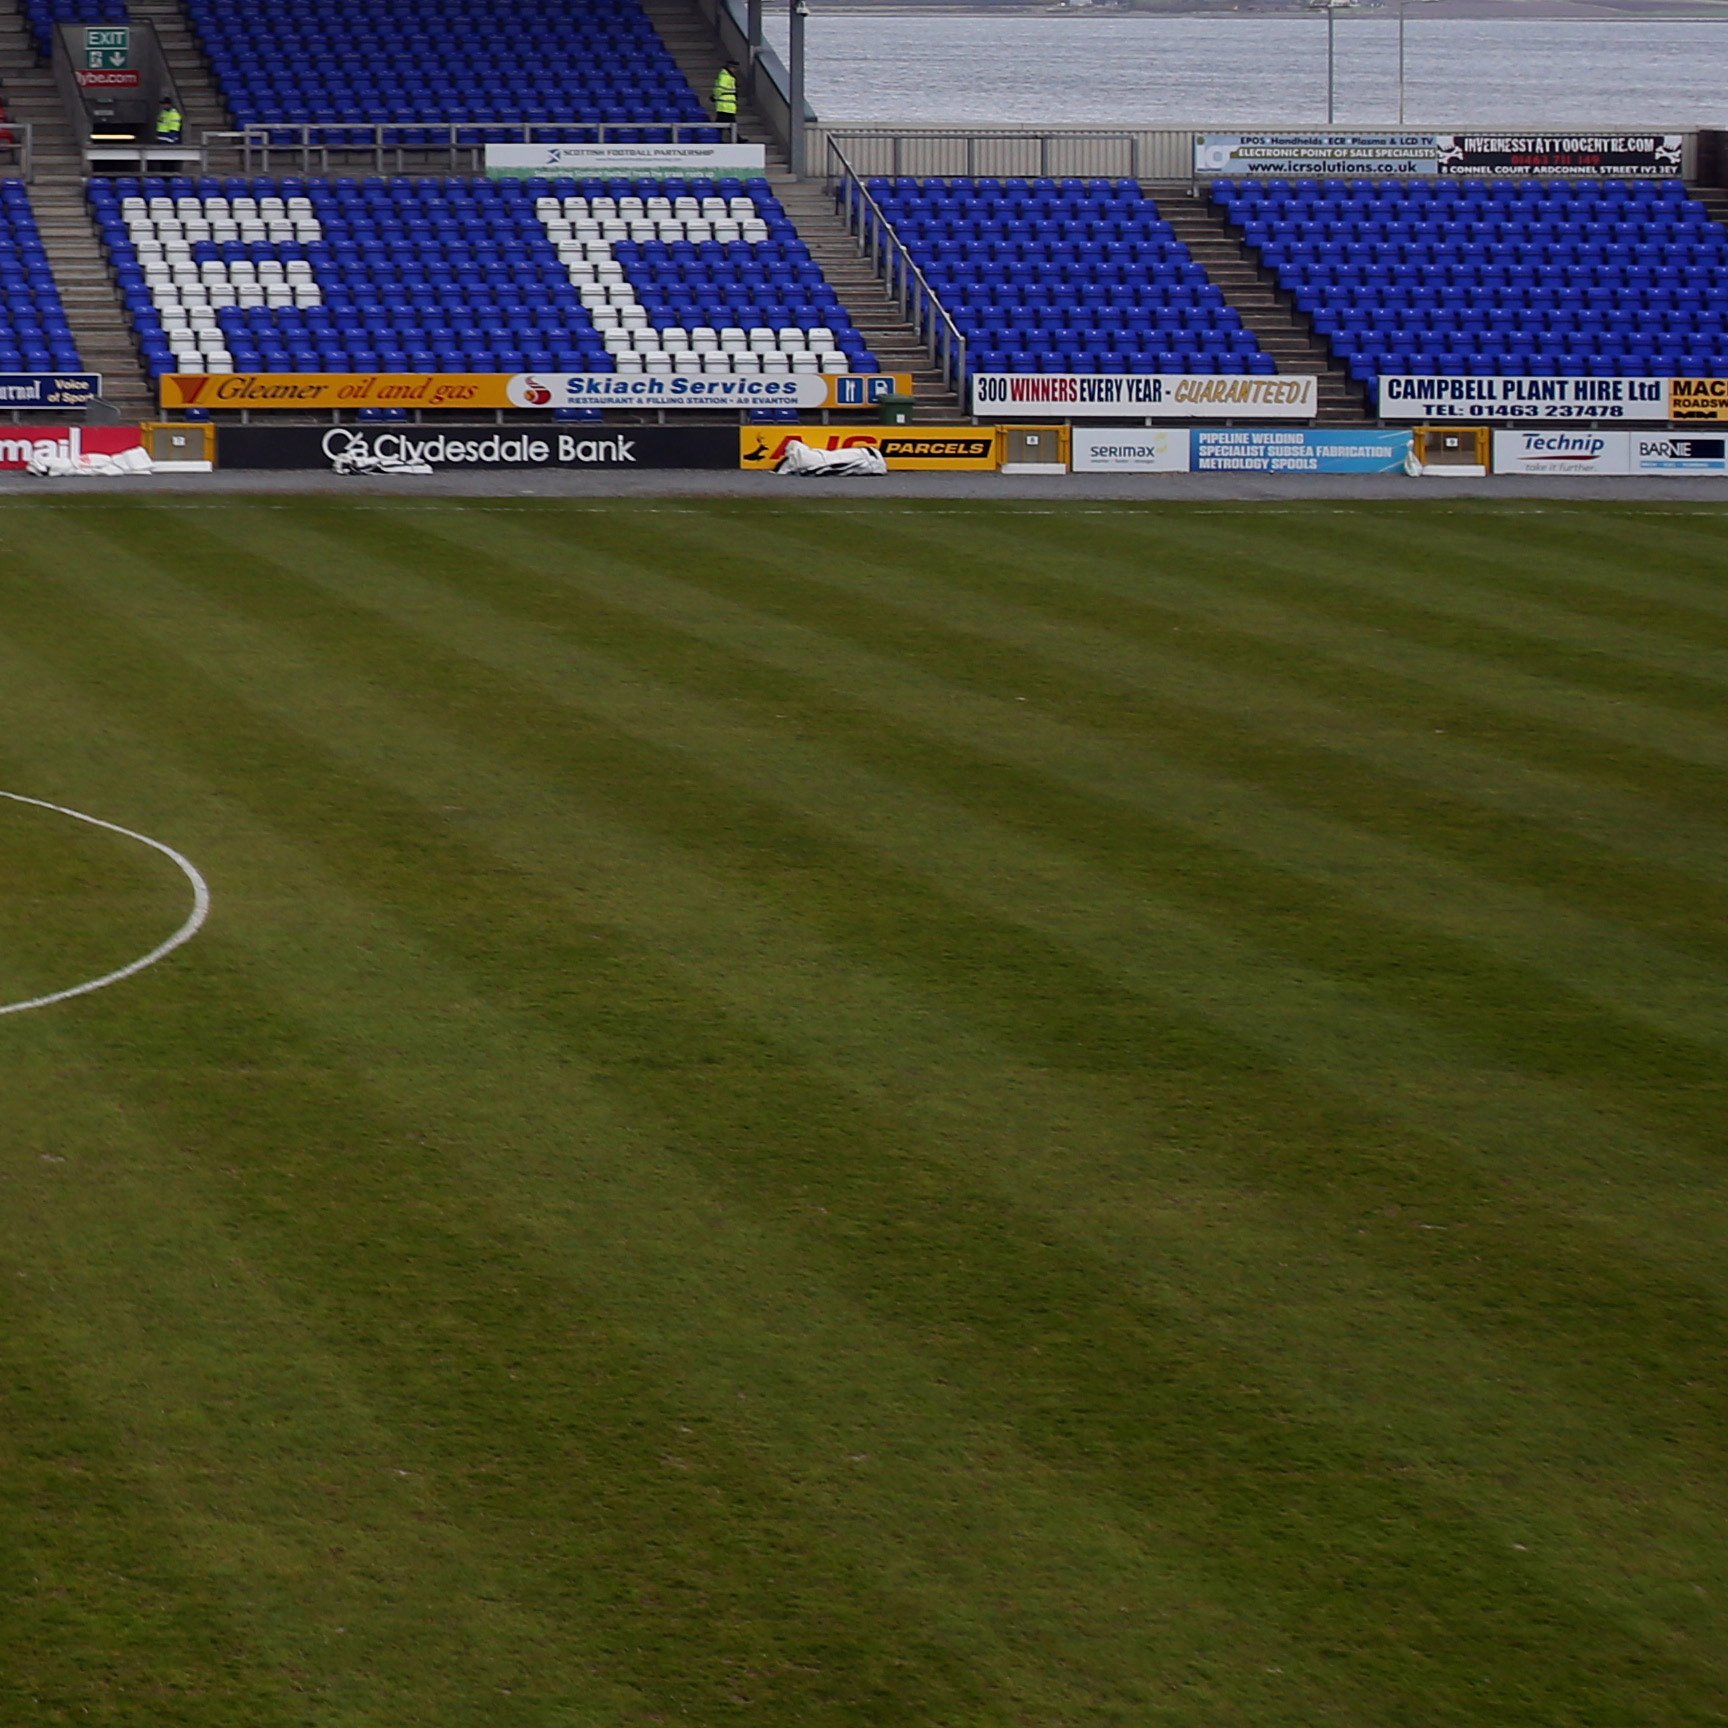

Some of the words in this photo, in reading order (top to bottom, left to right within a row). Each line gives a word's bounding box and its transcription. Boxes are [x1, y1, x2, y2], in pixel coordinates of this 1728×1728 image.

[89, 32, 125, 45] EXIT
[1248, 160, 1417, 172] www.icrsolutions.co.uk
[55, 379, 90, 389] Voice
[566, 377, 665, 394] Skiach
[671, 377, 798, 394] Services
[978, 377, 1007, 402] 300
[1010, 377, 1078, 402] WINNERS
[1080, 377, 1125, 402] EVERY
[1127, 377, 1162, 402] YEAR
[1174, 377, 1311, 402] GUARANTEED!
[1388, 379, 1497, 400] CAMPBELL
[1502, 379, 1569, 400] PLANT
[1574, 379, 1623, 400] HIRE
[1628, 379, 1661, 400] Ltd
[216, 378, 329, 404] Gleaner
[377, 378, 433, 404] and
[430, 378, 479, 404] gas
[1423, 405, 1464, 416] TEL:
[1470, 405, 1538, 416] 01463
[1544, 405, 1624, 416] 237478
[1199, 434, 1250, 444] PIPELINE
[1252, 434, 1304, 444] WELDING
[1522, 433, 1605, 454] Technip
[374, 434, 550, 462] Clydesdale
[558, 434, 637, 462] Bank
[886, 443, 984, 454] PARCELS
[1199, 446, 1265, 457] SPECIALIST
[1267, 446, 1315, 457] SUBSEA
[1316, 446, 1392, 457] FABRICATION
[1199, 459, 1269, 470] METROLOGY
[1271, 459, 1317, 470] SPOOLS
